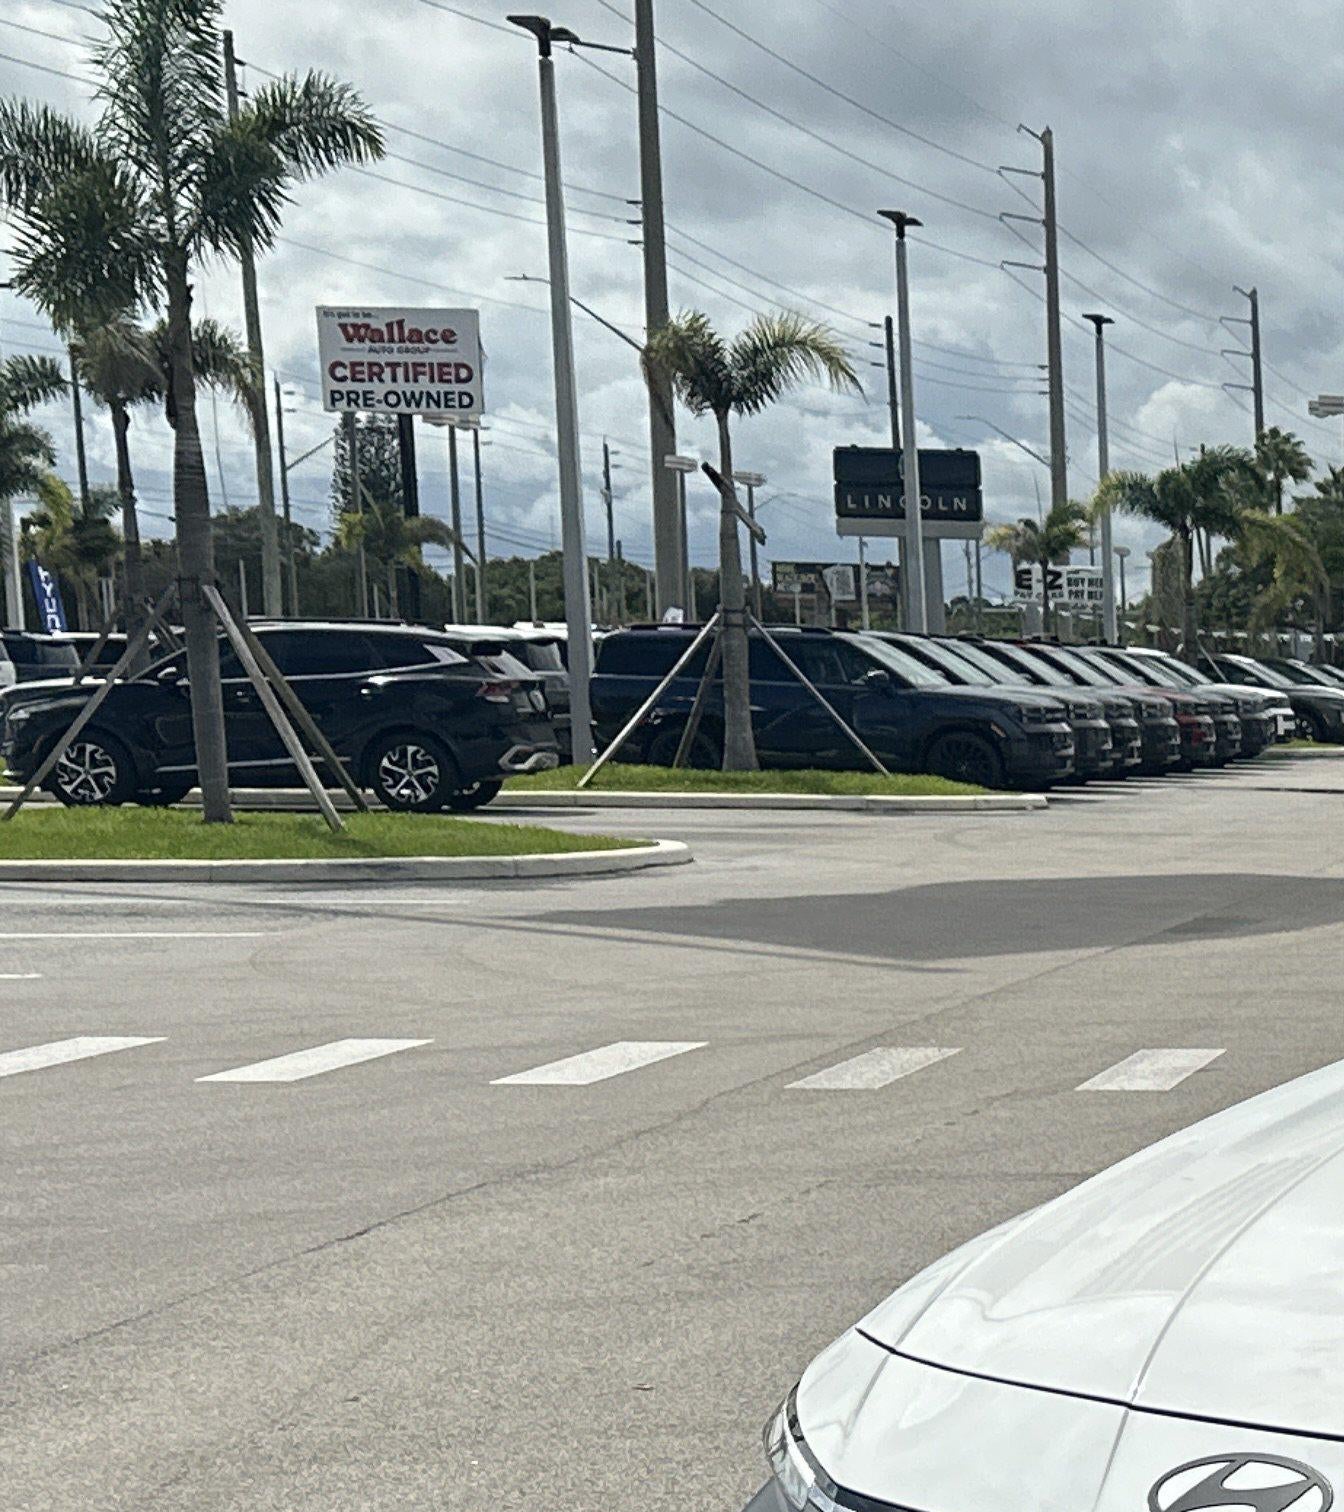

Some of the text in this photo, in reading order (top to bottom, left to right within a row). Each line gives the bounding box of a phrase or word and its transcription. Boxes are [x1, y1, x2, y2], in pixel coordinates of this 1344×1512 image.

[338, 318, 458, 344] Wallace
[396, 346, 431, 355] GROUP
[328, 360, 474, 384] CERTIFIED
[329, 389, 475, 409] PRE-OWNED
